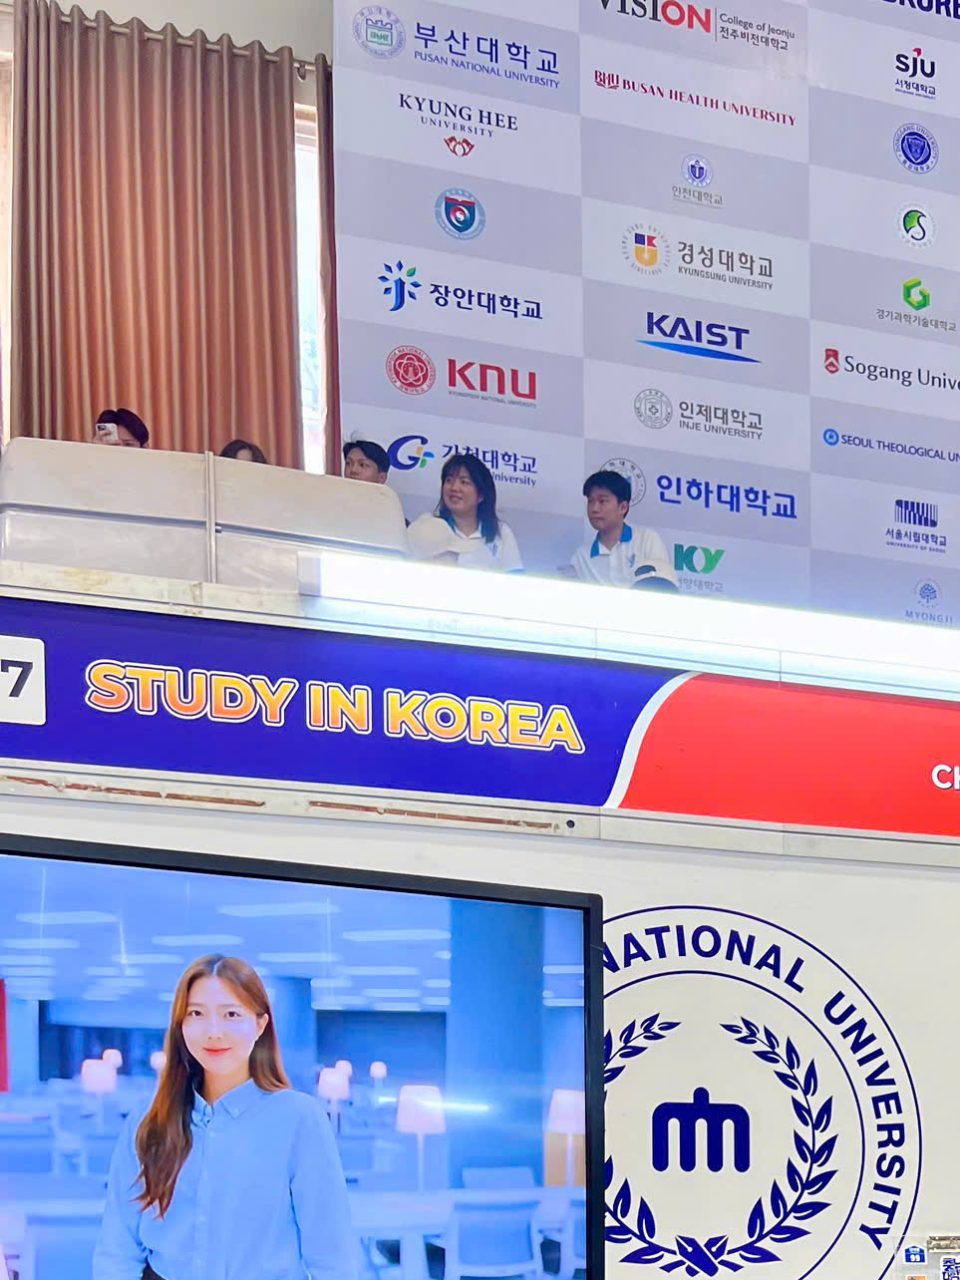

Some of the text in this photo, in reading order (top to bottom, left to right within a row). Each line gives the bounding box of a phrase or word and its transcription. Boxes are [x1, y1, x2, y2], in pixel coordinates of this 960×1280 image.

[719, 13, 795, 39] College of Jeonju
[719, 26, 789, 51] 전주비전대학교
[414, 22, 559, 75] 부산대학교
[414, 51, 561, 89] PUSAN NATIONAL UNIVERSITY
[399, 93, 519, 131] KYUNG HEE
[622, 79, 796, 126] BUSAN HEALTH UNIVERSITY
[420, 116, 495, 138] UNIVERSITY
[677, 241, 773, 278] 경성대학교
[678, 266, 773, 291] KYUNGSUNG UNIVERSITY
[429, 283, 543, 320] 장안대학교
[647, 312, 750, 350] KAIST
[876, 308, 957, 332] 경기과학기술대학교
[844, 355, 912, 387] Sogang
[679, 401, 763, 430] 인제대학교
[679, 420, 762, 440] INJE UNIVERSITY
[841, 434, 874, 449] SEOUL
[877, 440, 946, 461] THEOLOGICAL
[657, 475, 797, 519] 인하대학교
[885, 527, 947, 547] 서울시립대학교
[85, 660, 585, 753] STUDY IN KOREA
[823, 990, 906, 1251] UNIVERSITY
